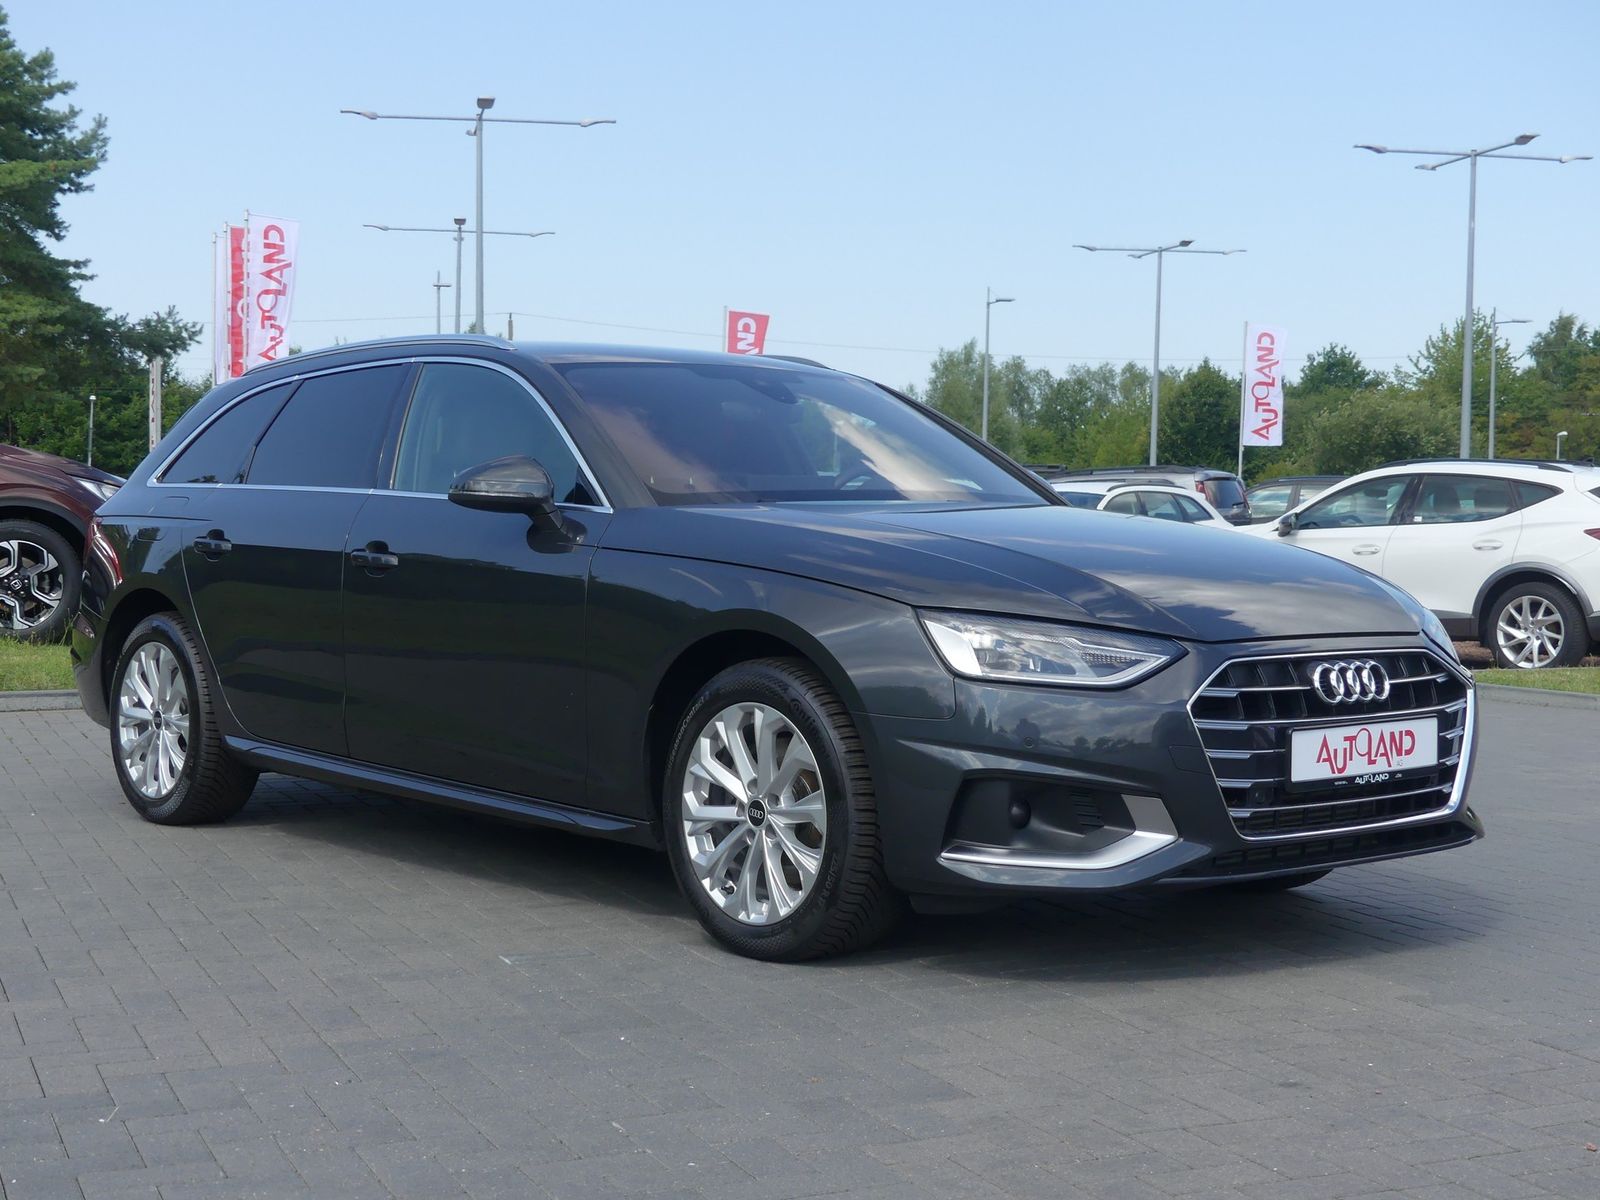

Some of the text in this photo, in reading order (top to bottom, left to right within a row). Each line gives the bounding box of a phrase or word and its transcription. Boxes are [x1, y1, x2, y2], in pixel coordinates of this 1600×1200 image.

[257, 224, 292, 362] AUTOLAND
[1251, 332, 1280, 440] AUTOLAND
[1316, 728, 1416, 774] AUTOLAND
[1354, 773, 1389, 785] AUTOLAND
